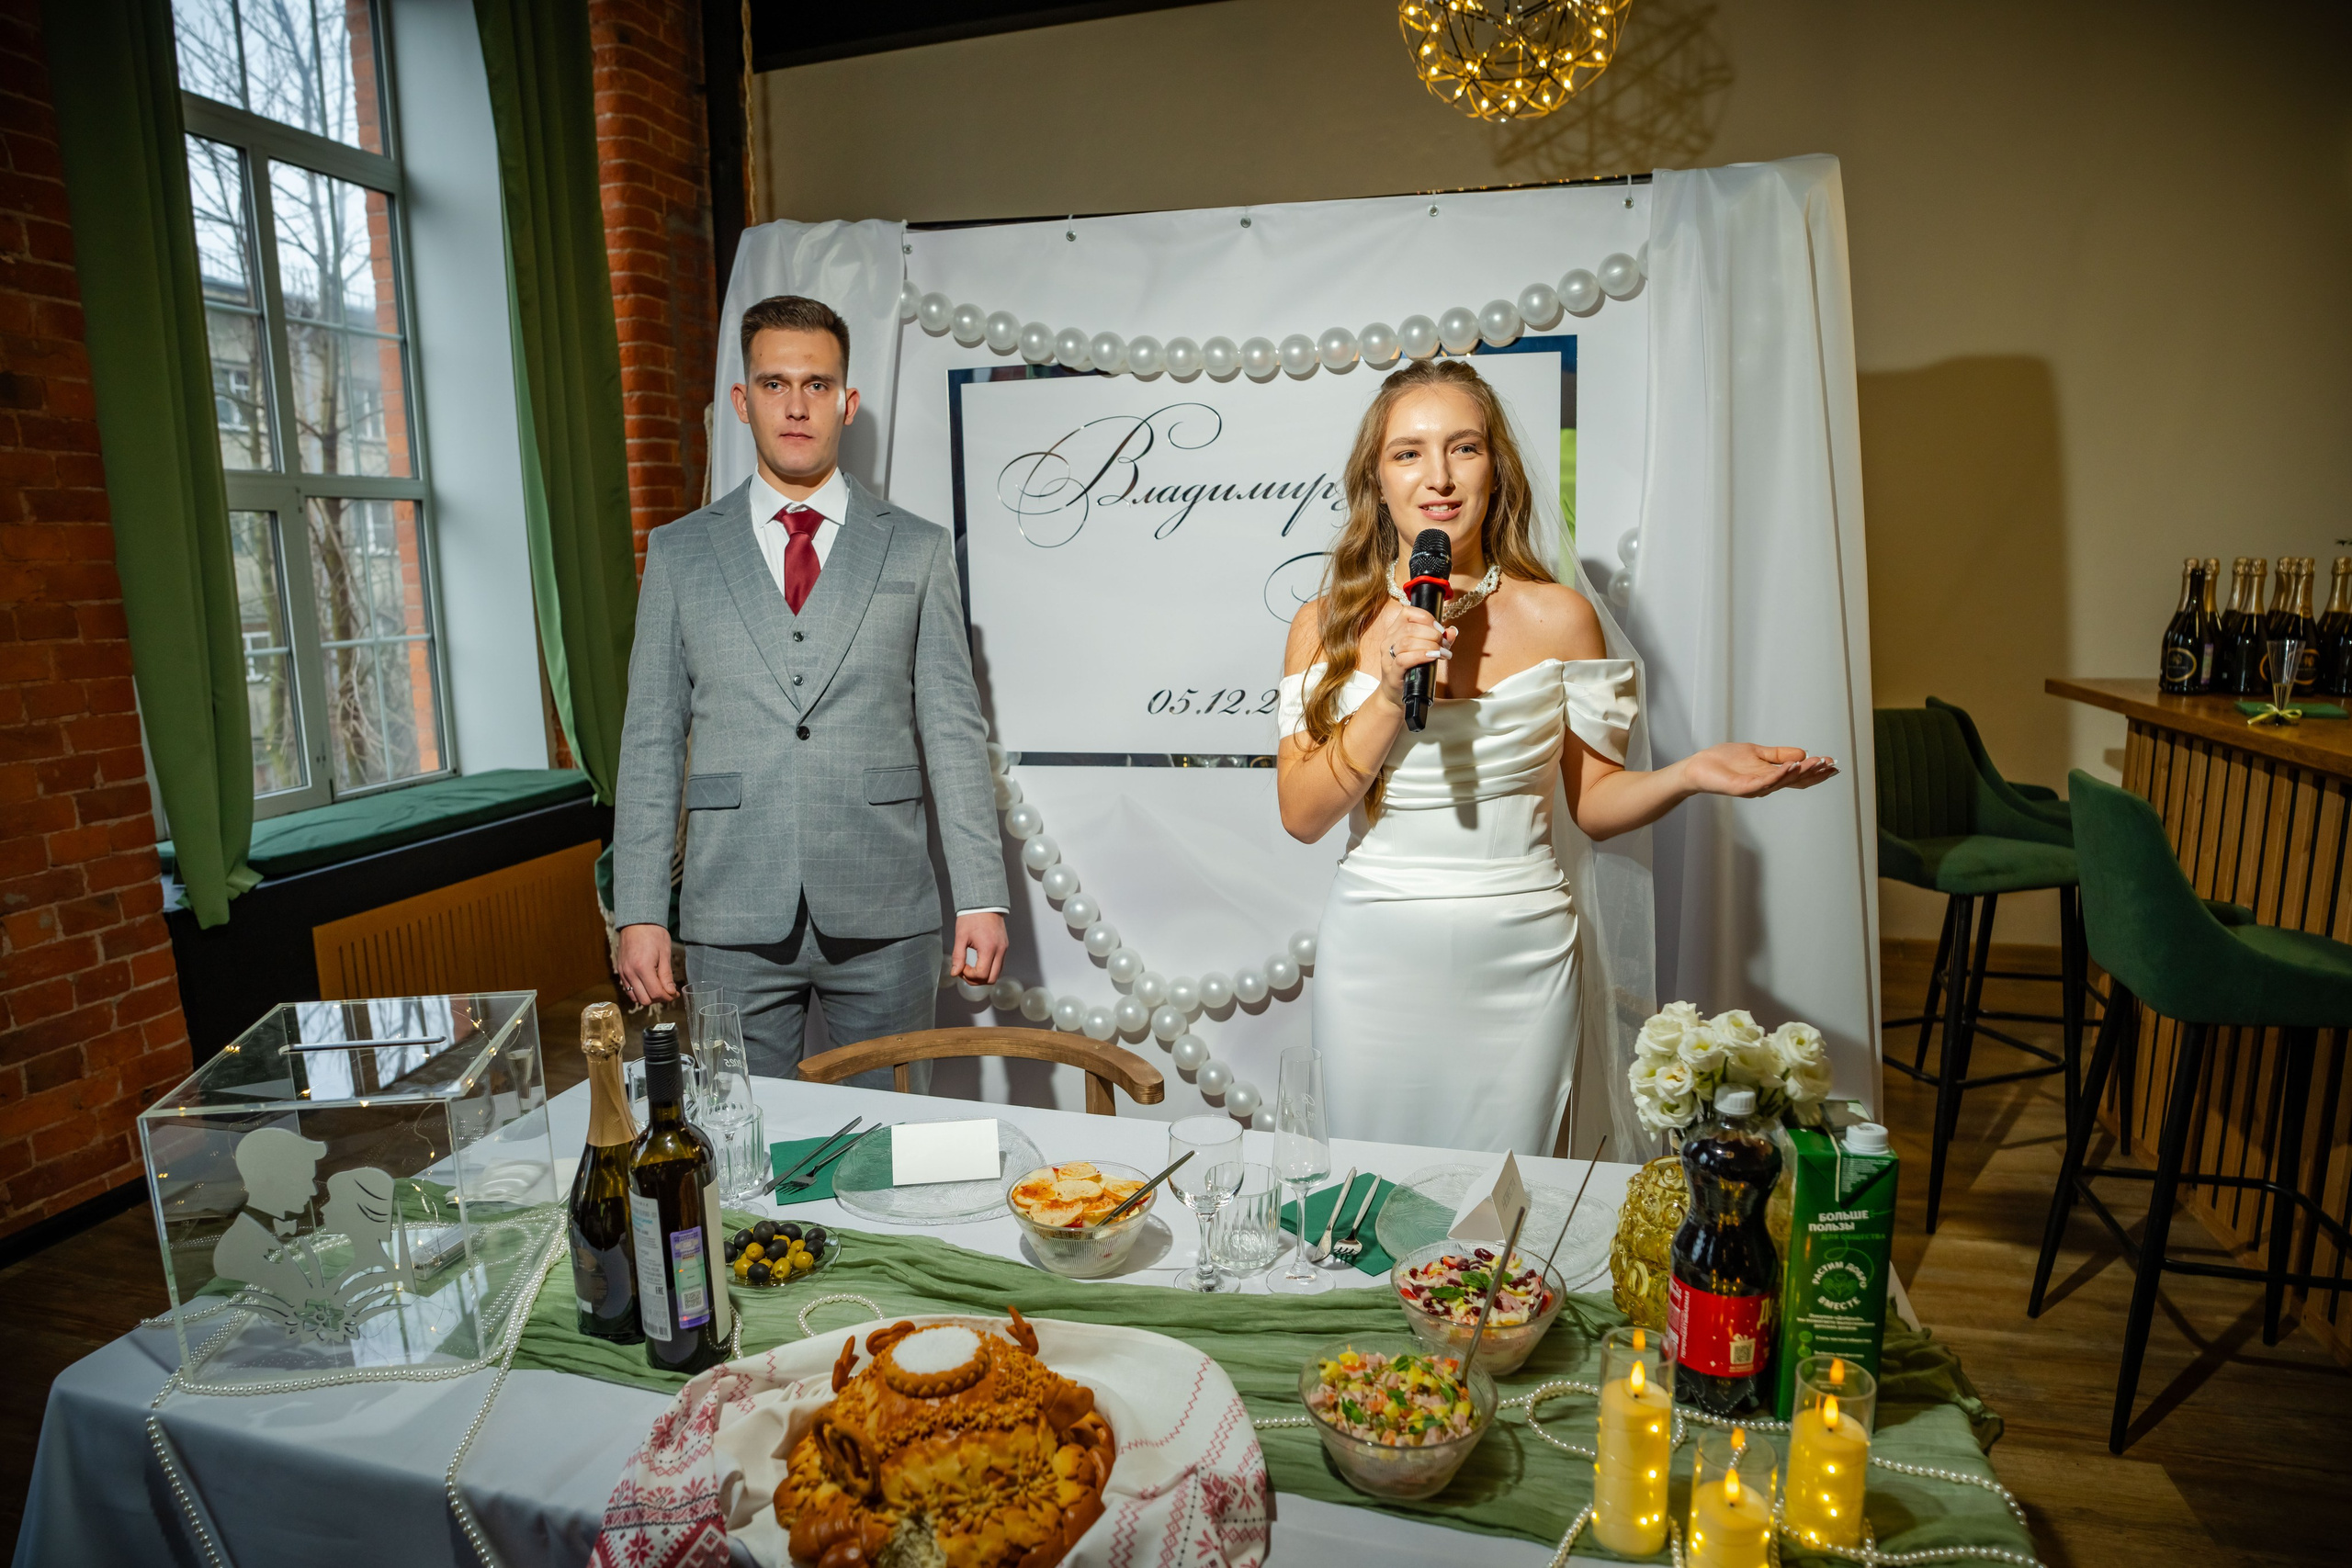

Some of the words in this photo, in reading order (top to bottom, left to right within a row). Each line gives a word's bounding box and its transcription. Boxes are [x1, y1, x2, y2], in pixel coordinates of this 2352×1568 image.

[997, 402, 1338, 548] Владимир
[1147, 688, 1281, 716] 05.12.2
[1808, 1223, 1856, 1232] ПОЛЬЗЫ
[1818, 1210, 1870, 1223] БОЛЬШЕ
[1812, 1261, 1844, 1285] РАСТИМ
[1817, 1293, 1861, 1313] ВМЕСТЕ
